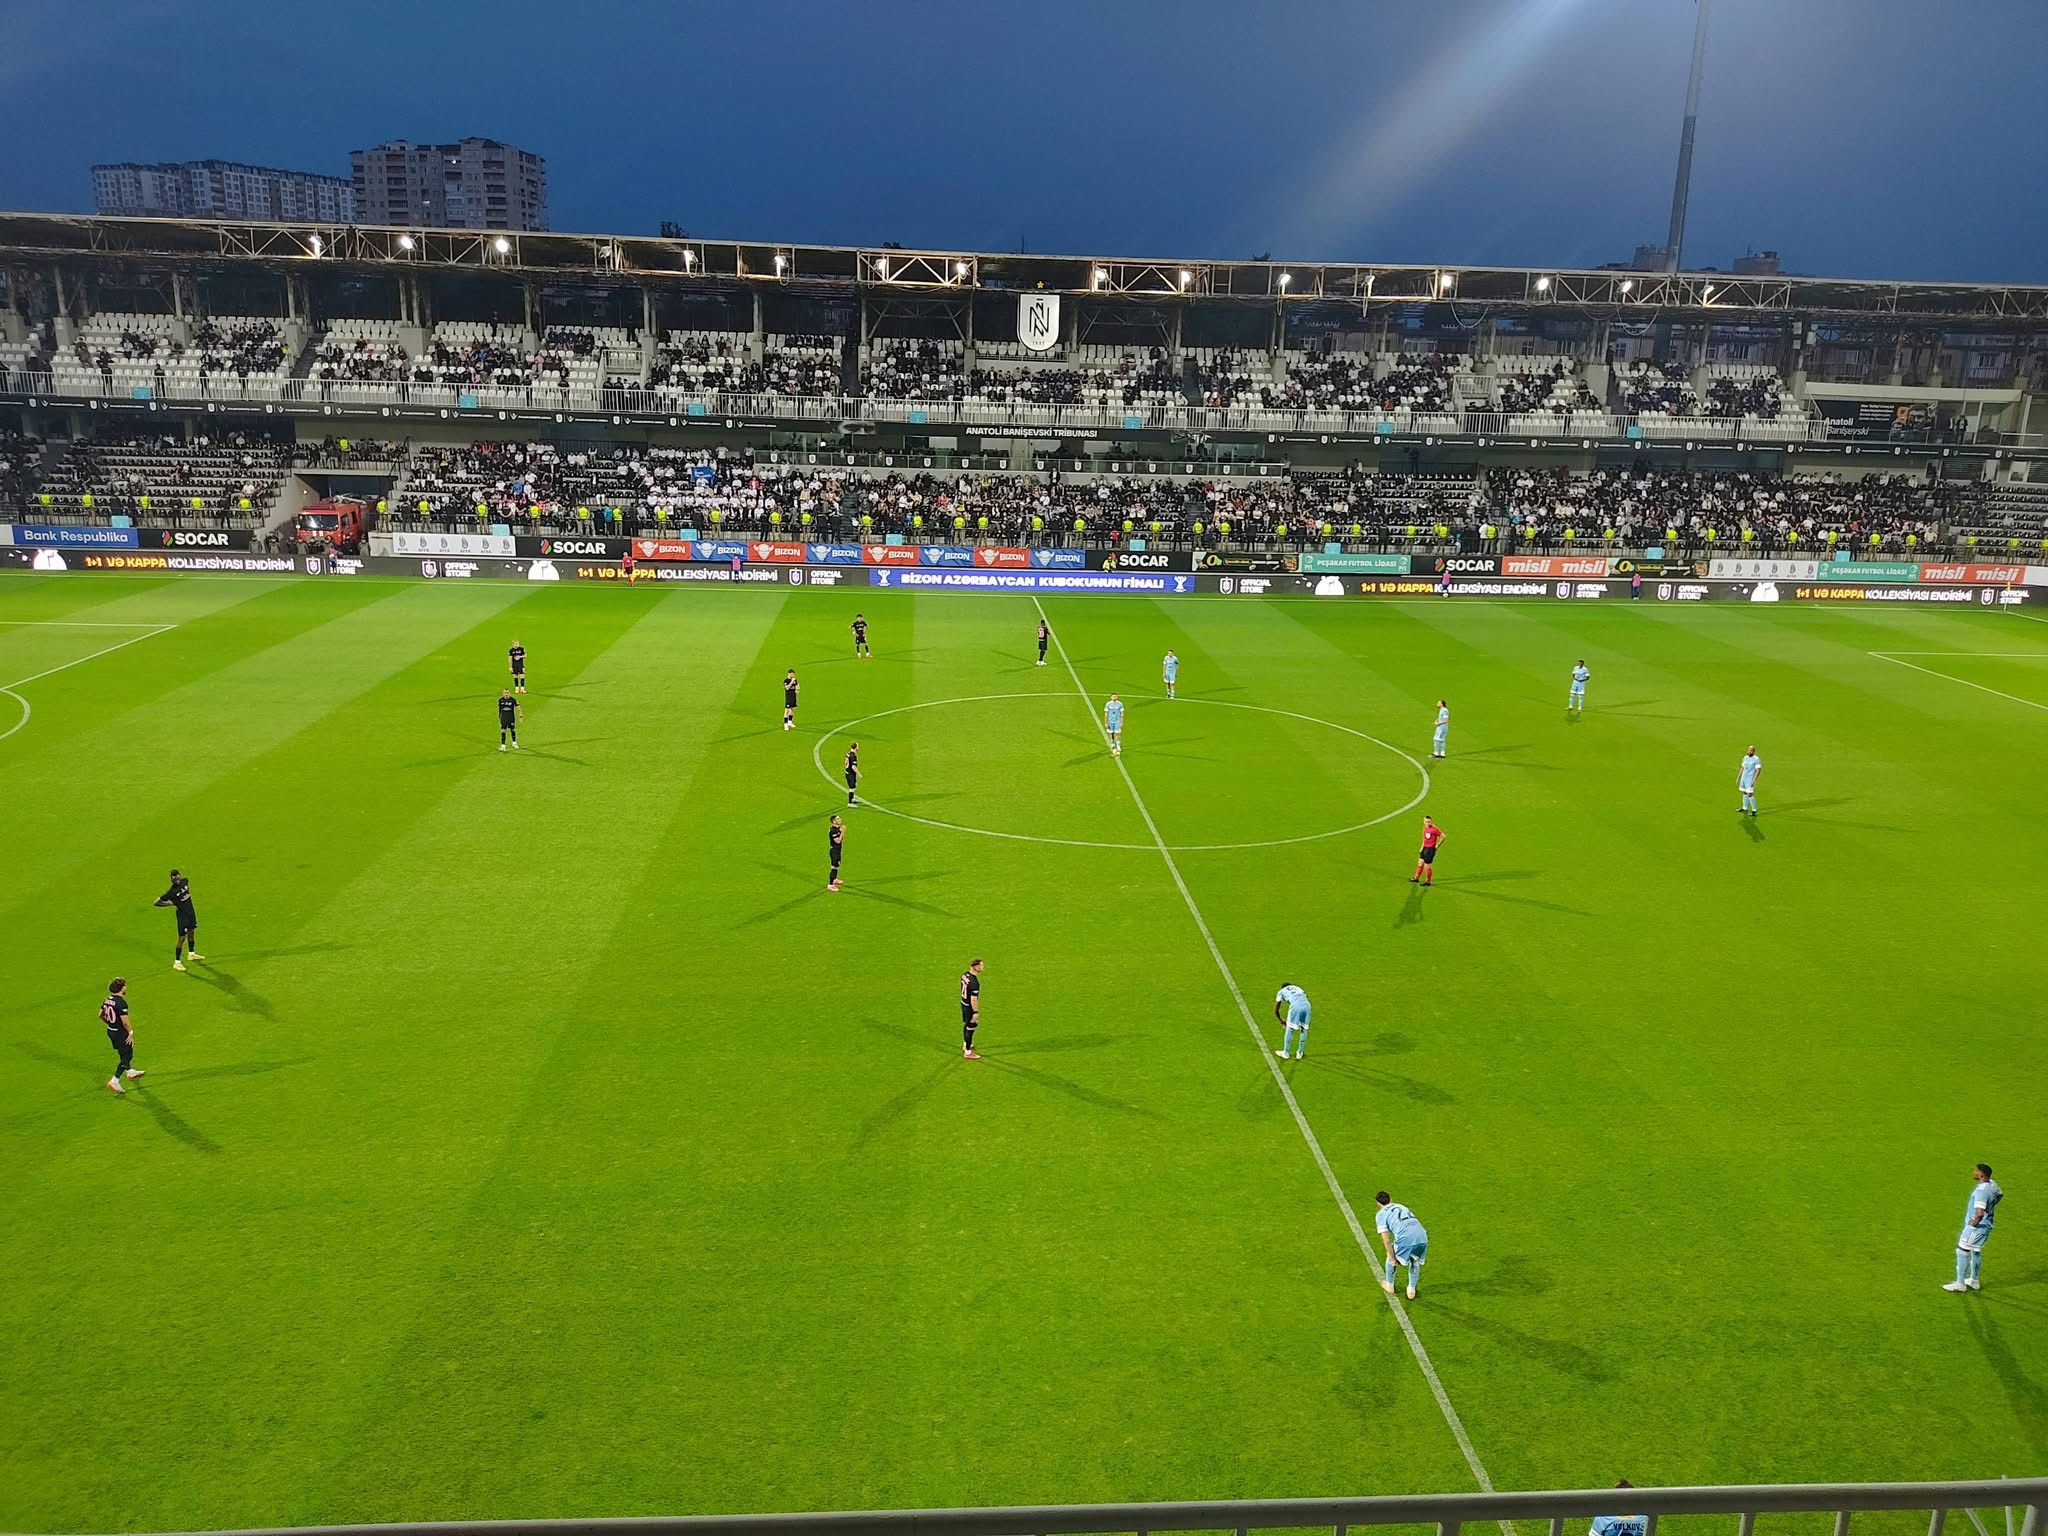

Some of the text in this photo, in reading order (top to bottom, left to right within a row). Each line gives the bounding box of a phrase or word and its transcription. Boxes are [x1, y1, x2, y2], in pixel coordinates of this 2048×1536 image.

[966, 426, 1098, 438] ANATOLİ BANİŞEVSKİ TRİBUNASI
[24, 530, 128, 543] Bank Respublika
[174, 532, 229, 546] SOCAR
[554, 542, 606, 554] SOCAR
[659, 546, 686, 554] BIZON
[718, 546, 744, 555] BIZON
[775, 548, 800, 556] BIZON
[832, 550, 858, 558] BIZON
[888, 552, 914, 560] BIZON
[944, 552, 970, 560] BIZON
[1000, 553, 1025, 562] BIZON
[1056, 554, 1080, 562] BIZON
[1119, 554, 1169, 567] SOCAR
[85, 556, 294, 571] 1+1 VƏ KAPPA KOLLEKSİYASI ENDİRİMİ
[328, 559, 364, 567] FFICIAL
[445, 562, 479, 570] OFFICIAL
[1446, 559, 1495, 571] SOCAR
[1507, 560, 1551, 573] misli
[1562, 561, 1606, 574] misli
[577, 568, 593, 578] 1+1
[598, 568, 616, 578] VƏ
[657, 568, 730, 581] KOLLEKSİYASI
[810, 570, 842, 578] OFFICIAL
[1925, 566, 1966, 580] misli
[1976, 567, 2018, 581] misli
[901, 572, 1164, 589] BİZON AZƏRBAYCAN KUBOKUNUN FİNALI
[1240, 578, 1272, 587] OFFICIAL
[1361, 583, 1376, 592] 1+1
[1379, 584, 1396, 593] VƏ
[1397, 584, 1433, 593] KAPPA
[1503, 582, 1547, 595] ENDİRİMİ
[1678, 585, 1709, 593] OFFICIAL
[1795, 588, 1972, 601] 1+1 VƏ KAPPA KOLLEKSİYASI ENDİRİMİ
[2000, 589, 2030, 597] OFFICIAL
